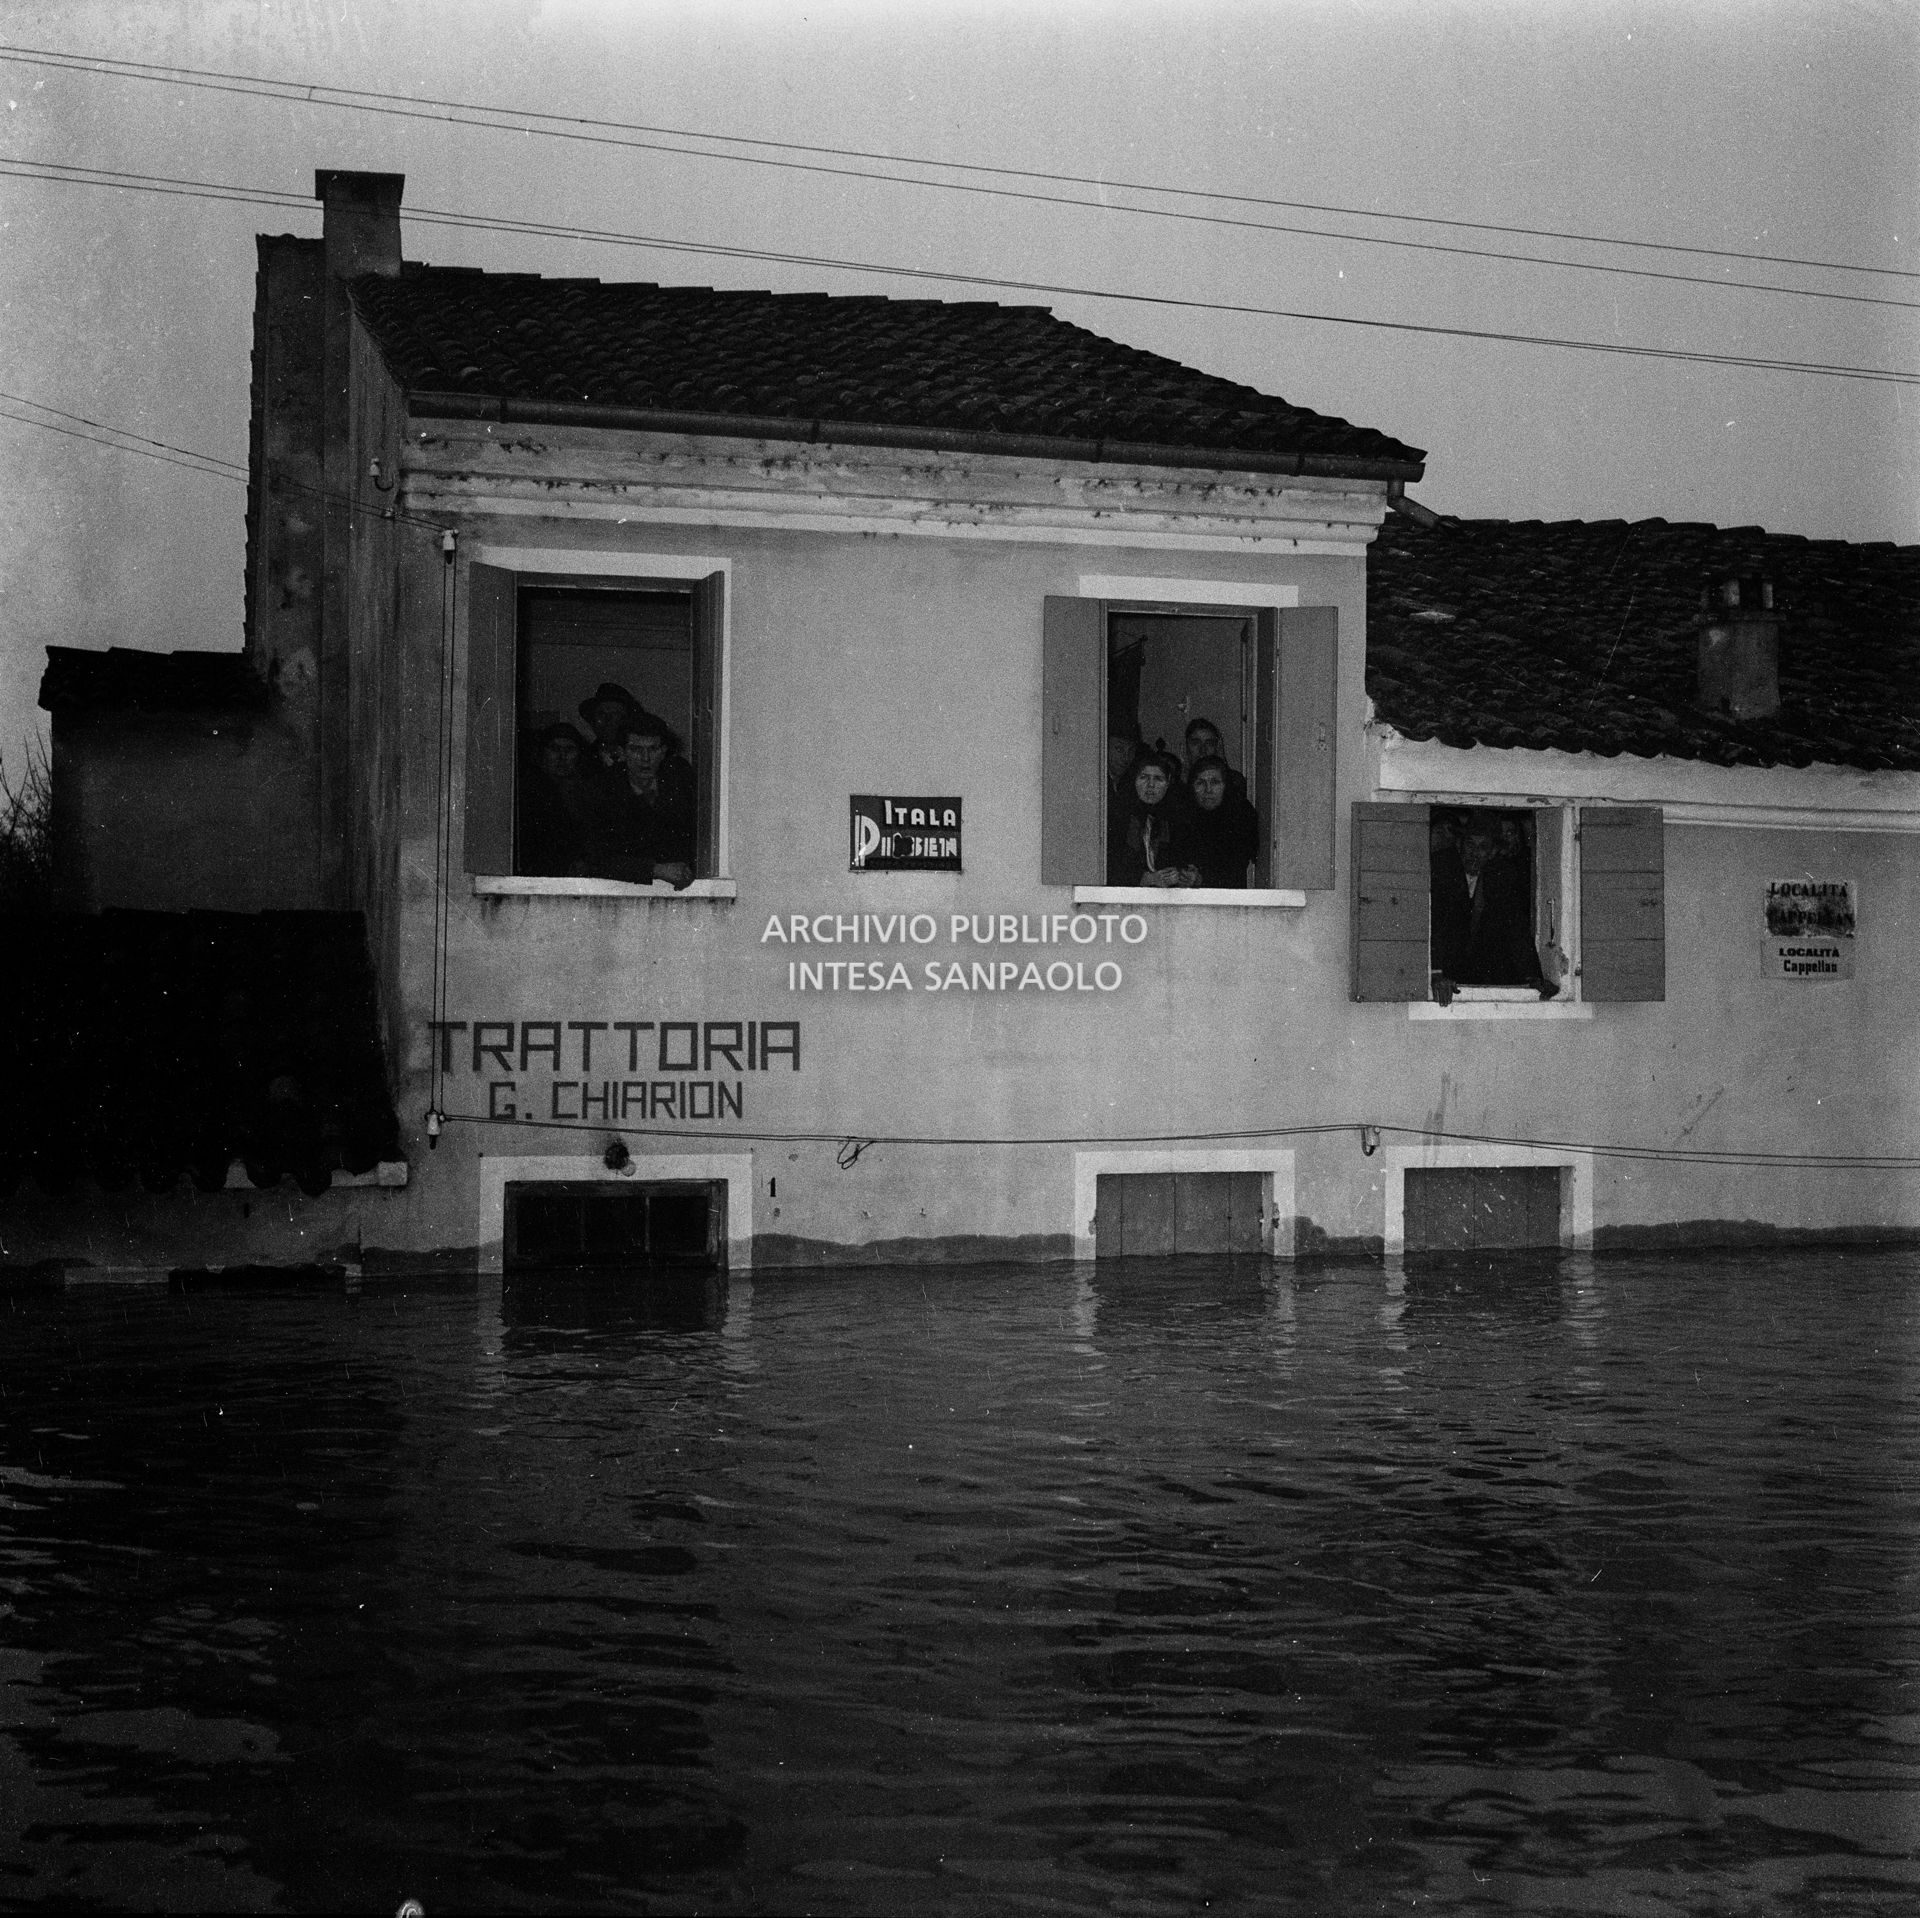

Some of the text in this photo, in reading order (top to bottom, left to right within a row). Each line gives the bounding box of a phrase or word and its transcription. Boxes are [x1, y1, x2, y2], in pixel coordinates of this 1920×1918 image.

[884, 799, 957, 827] ITALA
[1778, 946, 1841, 958] LOCALITÀ
[1783, 959, 1838, 976] Cappellan
[427, 1020, 801, 1073] TRATTORIA
[489, 1080, 743, 1121] G. CHIARION
